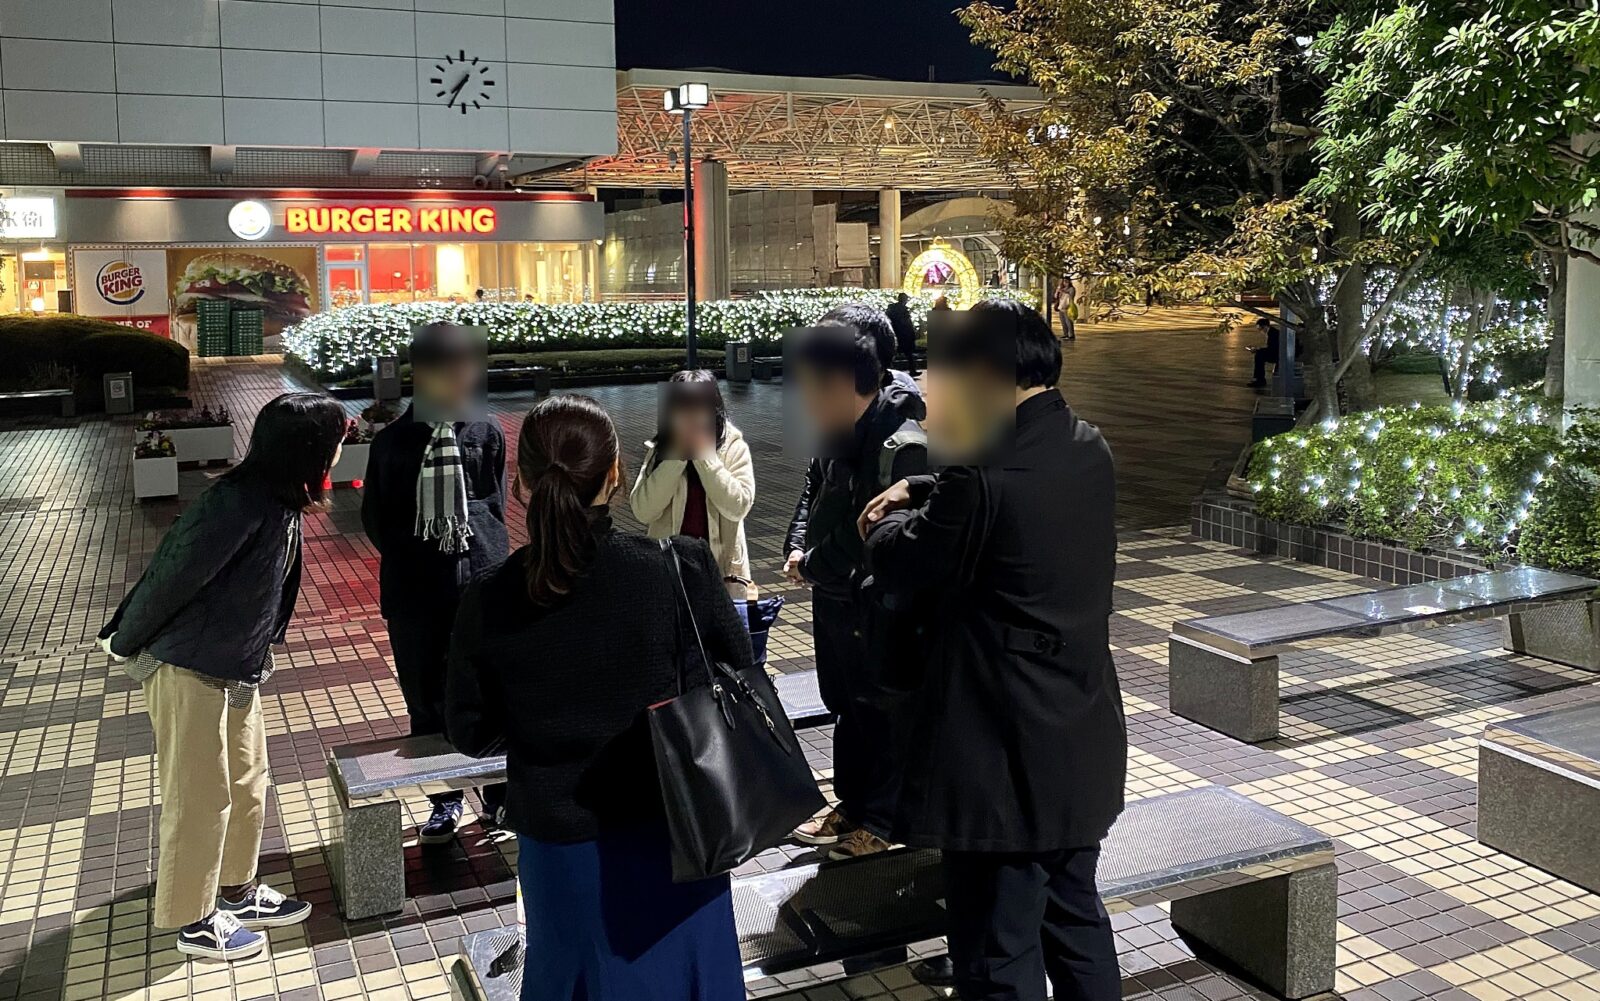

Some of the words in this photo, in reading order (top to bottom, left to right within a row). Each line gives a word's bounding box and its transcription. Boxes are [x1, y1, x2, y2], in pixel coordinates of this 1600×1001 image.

[286, 207, 413, 233] BURGER
[419, 207, 495, 233] KING
[101, 267, 141, 285] BURGER
[103, 276, 143, 297] KING
[115, 320, 134, 328] ME
[136, 320, 152, 329] OF
